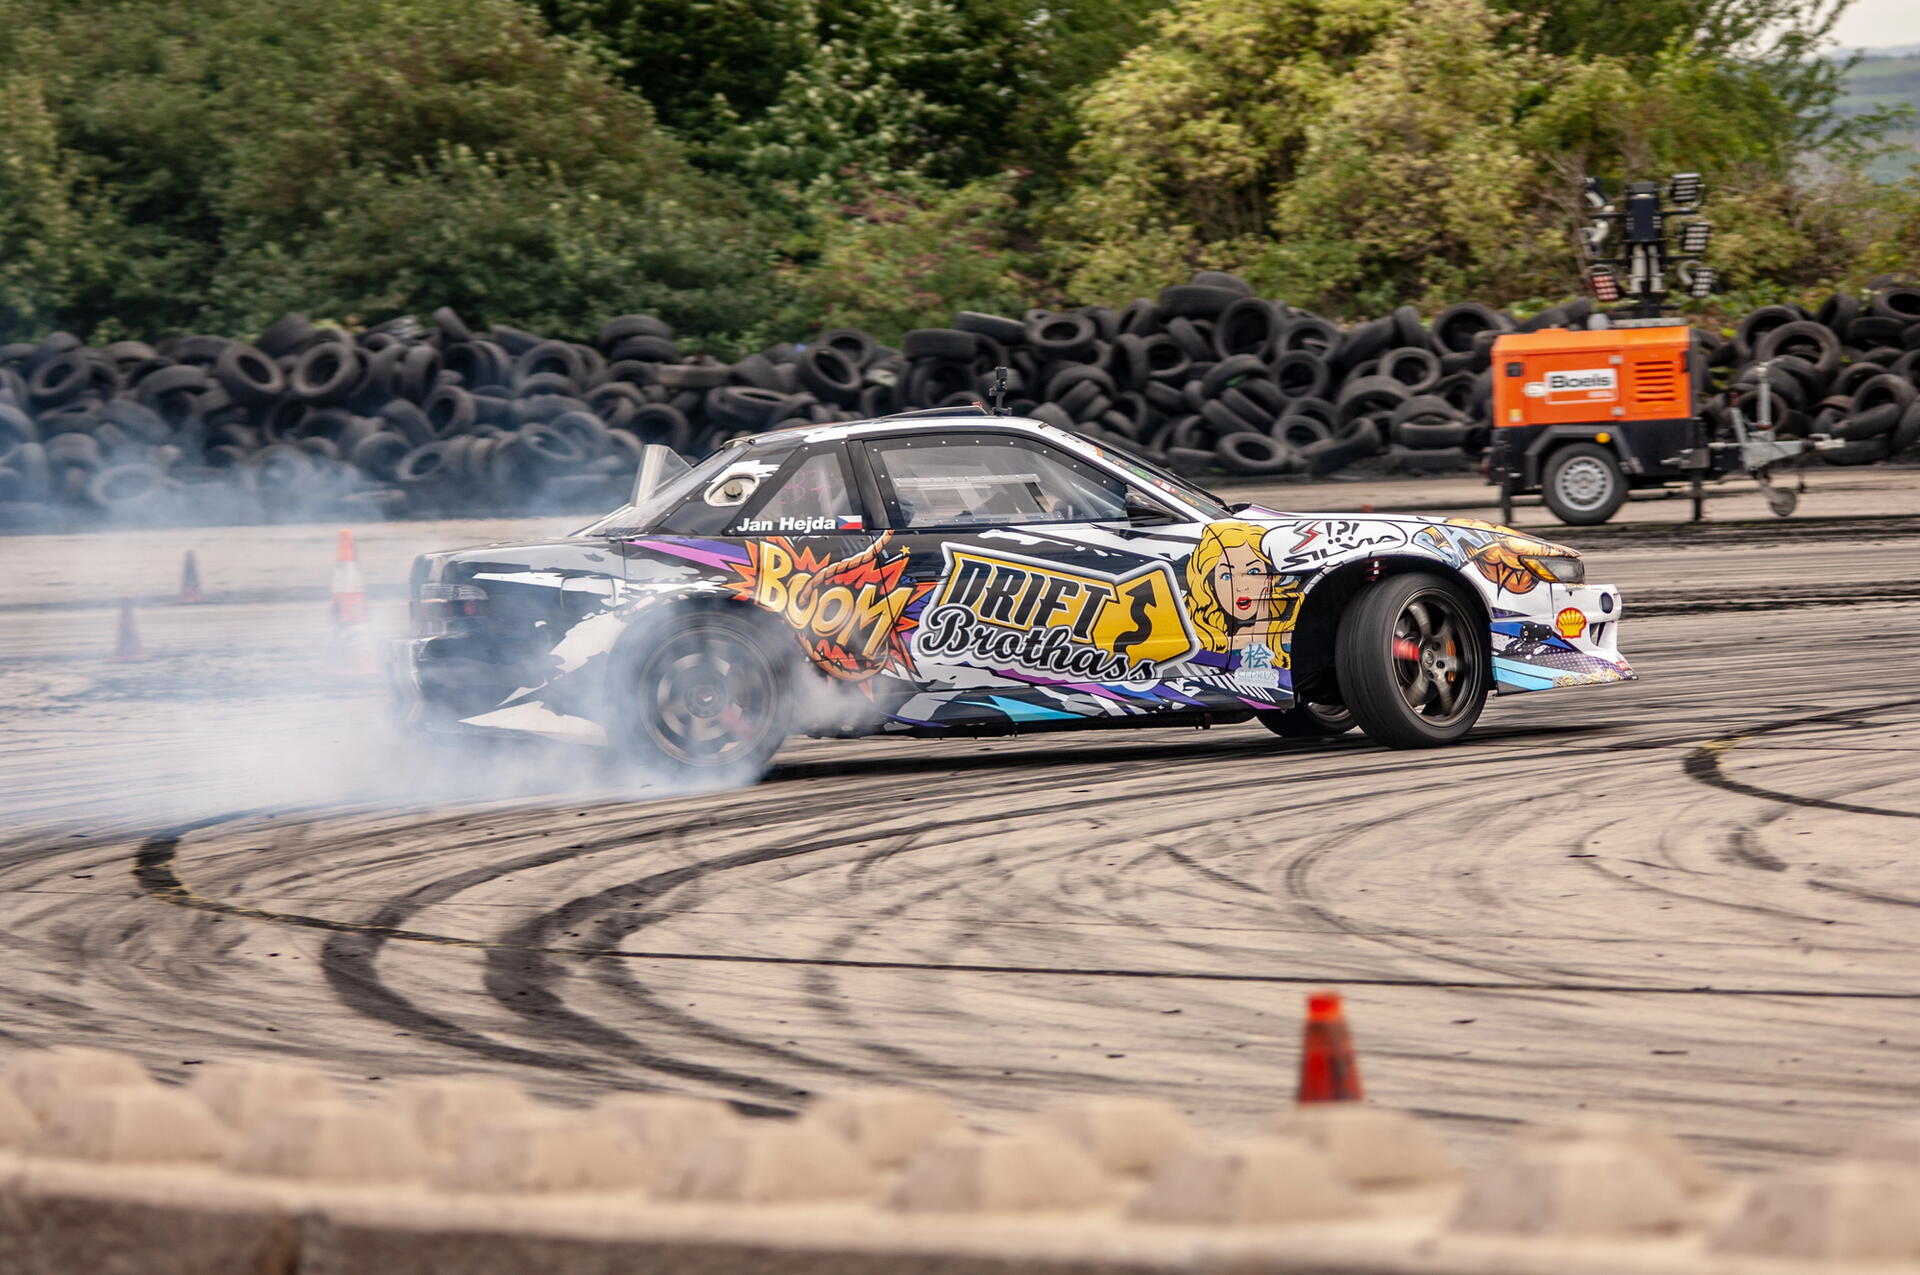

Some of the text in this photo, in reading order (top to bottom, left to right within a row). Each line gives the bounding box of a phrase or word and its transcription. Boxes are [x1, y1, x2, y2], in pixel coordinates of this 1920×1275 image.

[736, 516, 837, 534] Jan Hejda
[756, 540, 914, 660] BOOM
[952, 559, 1114, 641] DRIFT
[922, 605, 1157, 681] Brothass
